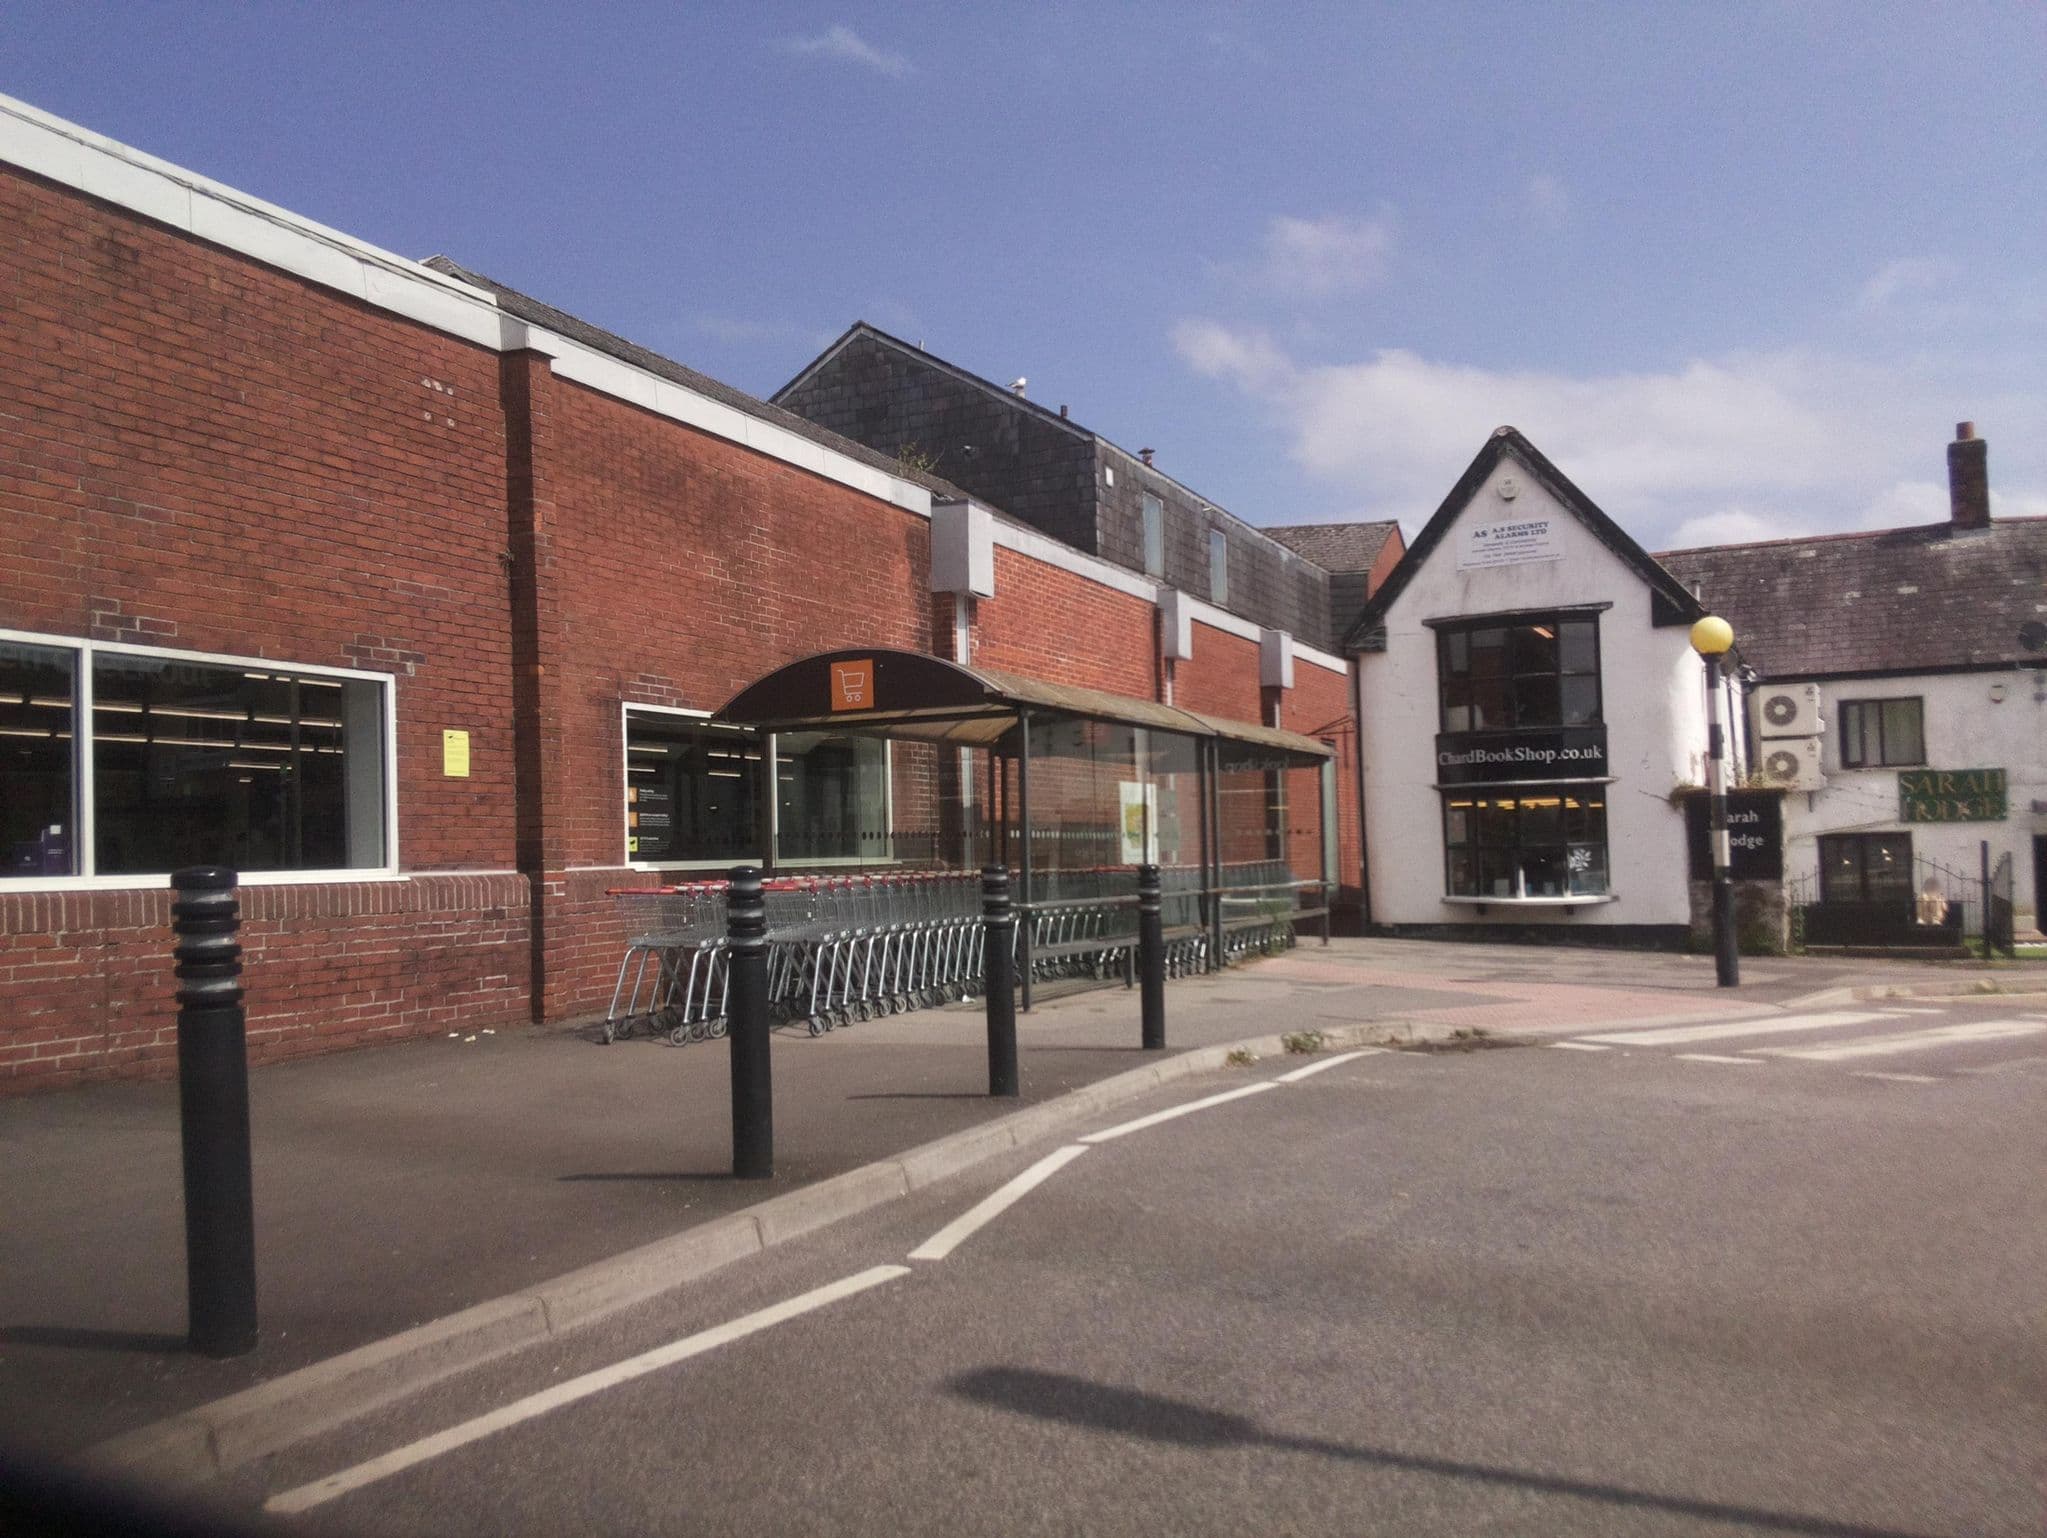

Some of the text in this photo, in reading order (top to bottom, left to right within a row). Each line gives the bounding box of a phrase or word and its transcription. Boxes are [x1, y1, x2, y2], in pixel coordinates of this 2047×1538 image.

[1507, 521, 1549, 532] SECURITY
[1472, 530, 1488, 539] AS
[1495, 528, 1547, 540] ALARMS LTD
[1900, 770, 2006, 795] SARAH
[1718, 809, 1761, 824] arah
[1718, 833, 1765, 850] odge
